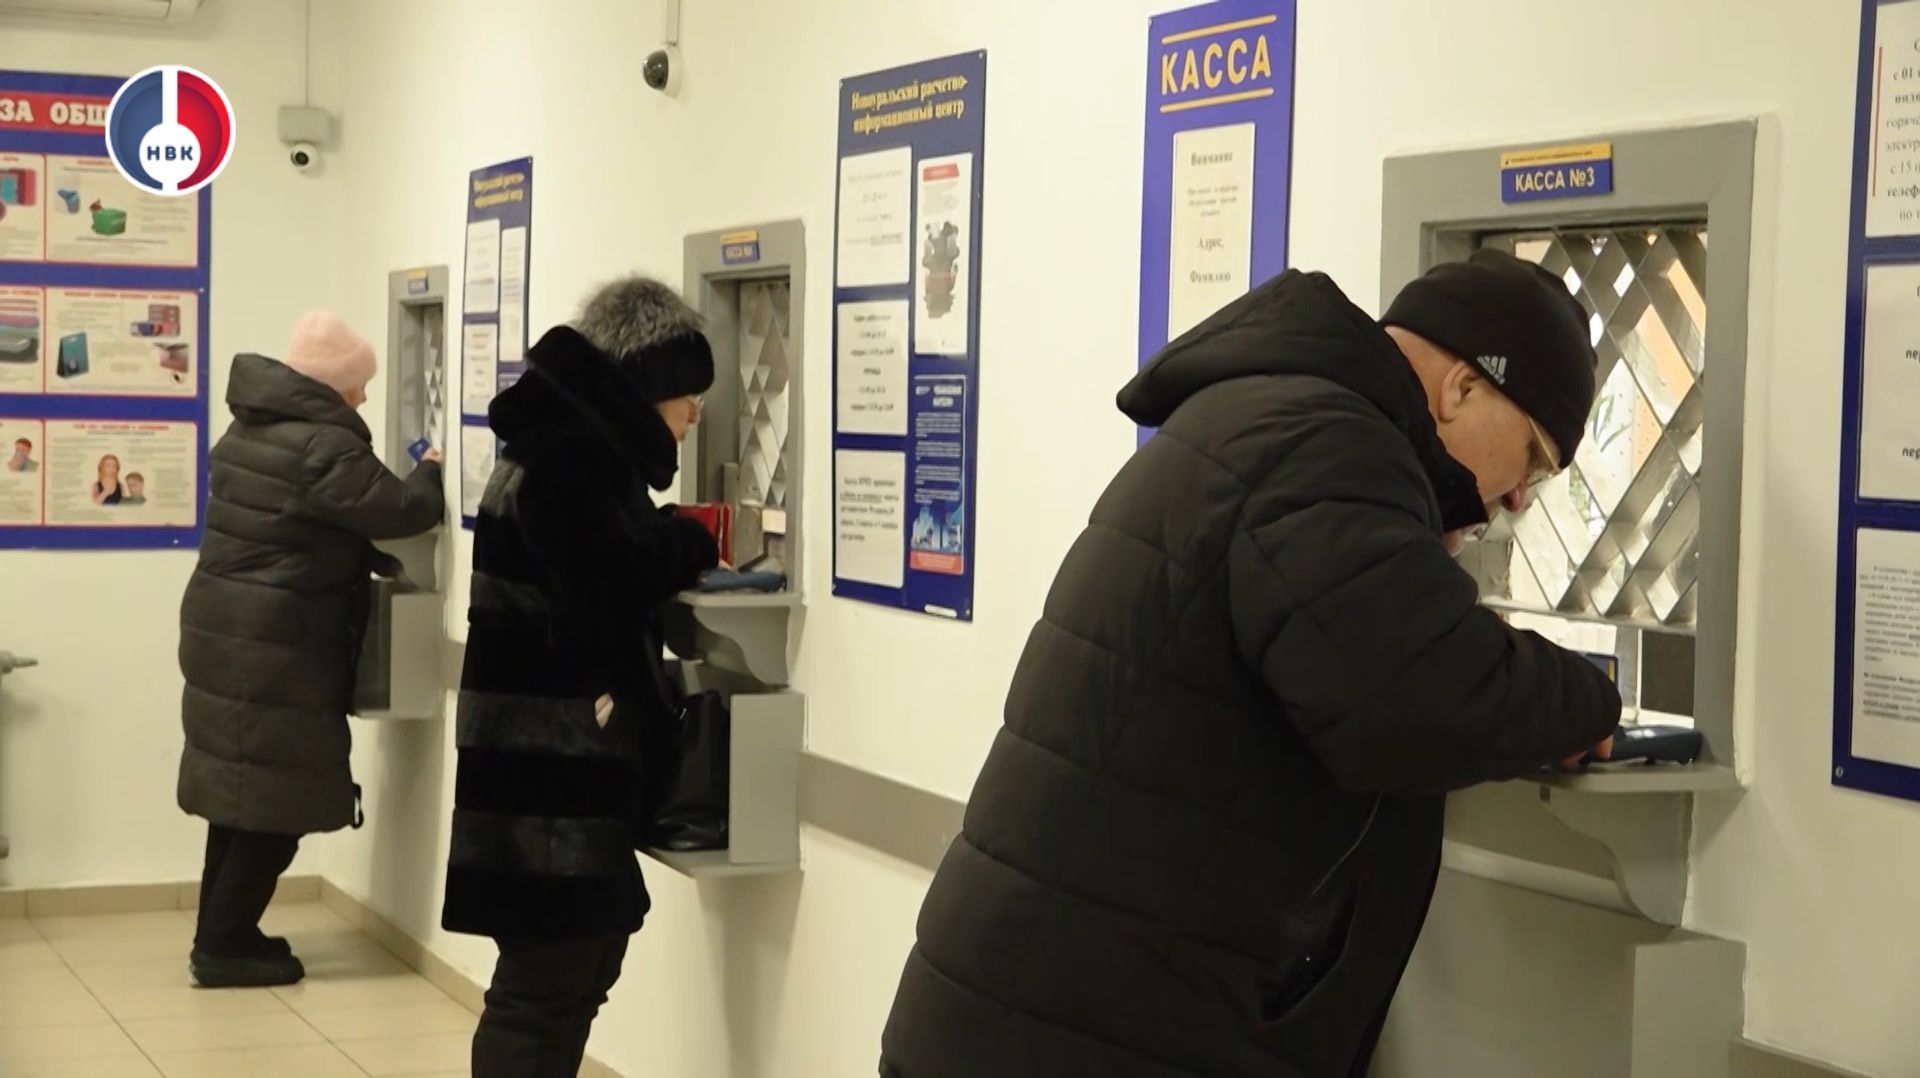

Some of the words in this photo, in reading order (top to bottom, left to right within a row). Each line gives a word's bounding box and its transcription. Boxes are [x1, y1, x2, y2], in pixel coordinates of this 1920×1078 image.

[1161, 35, 1271, 95] КАССА
[1515, 169, 1566, 192] КАССА
[1569, 166, 1595, 188] №3
